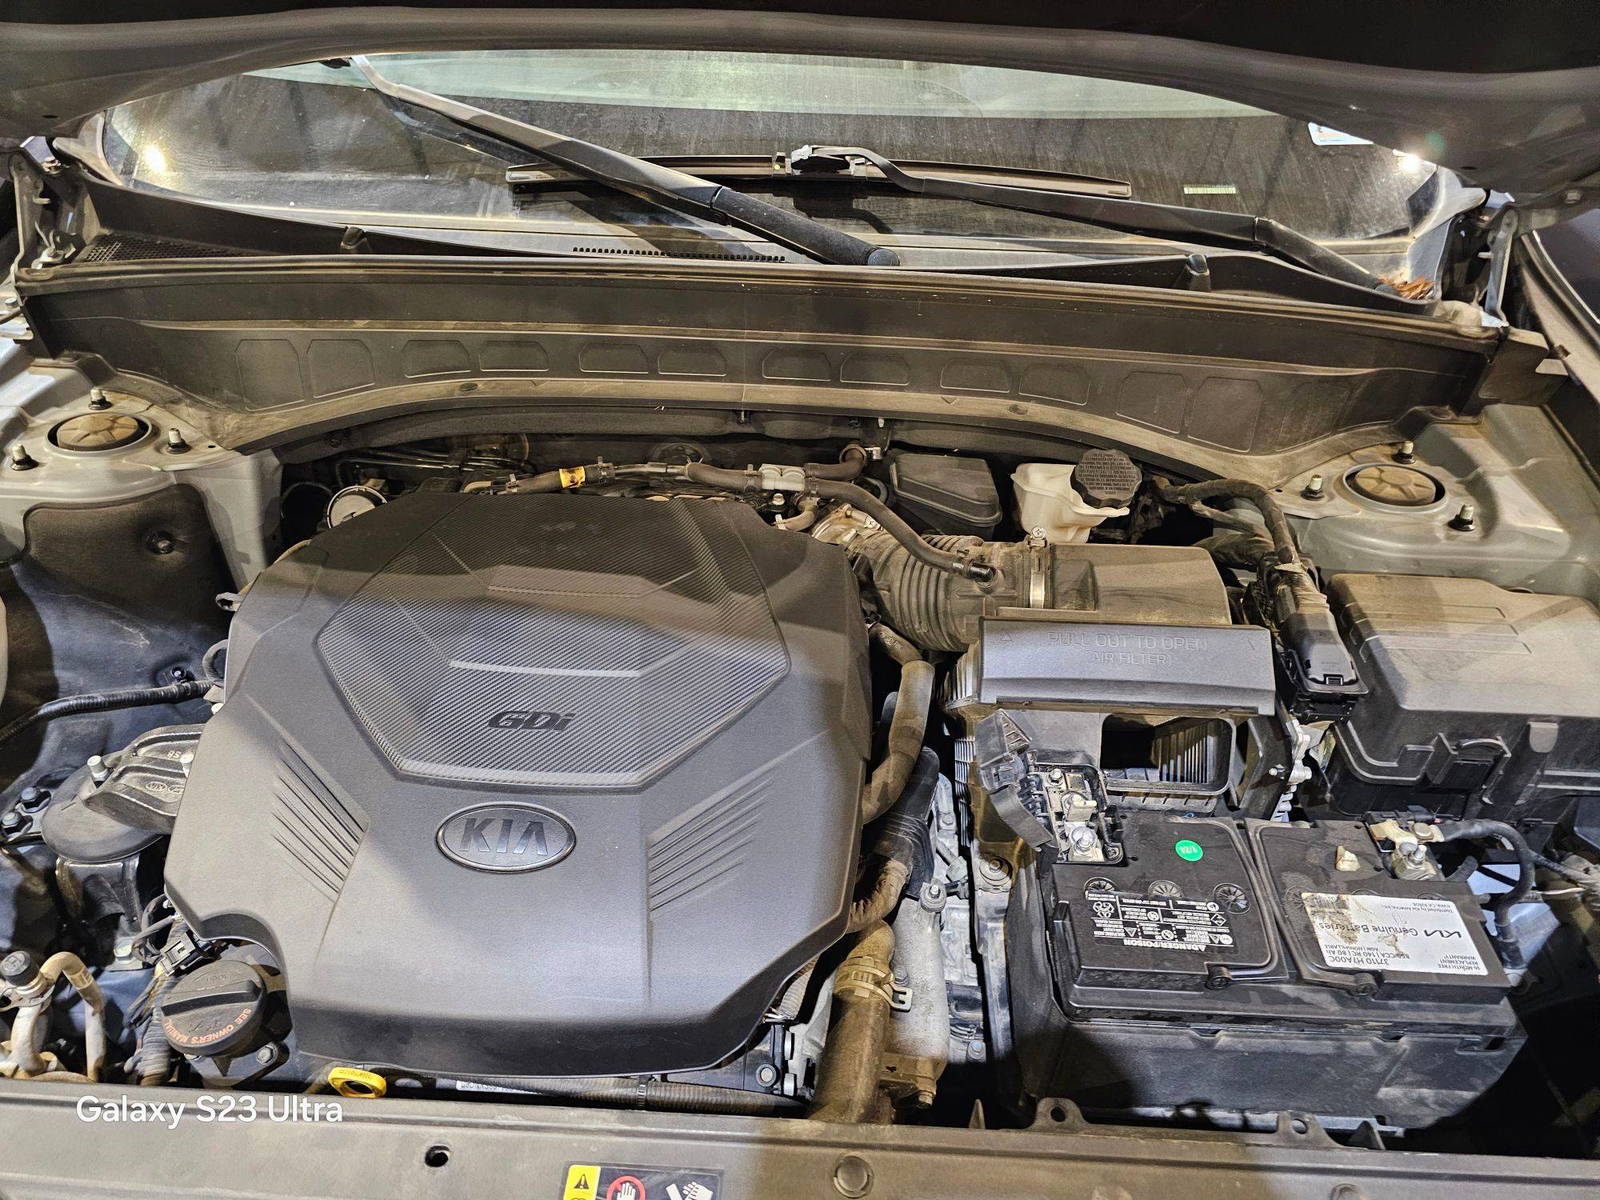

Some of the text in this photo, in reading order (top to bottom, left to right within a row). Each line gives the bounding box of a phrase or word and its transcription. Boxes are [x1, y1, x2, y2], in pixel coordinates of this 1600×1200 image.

[1047, 632, 1208, 651] PULL OUT TO OPEN
[488, 710, 576, 731] GDi
[460, 817, 549, 856] KIA
[1319, 922, 1370, 933] Batteries
[1372, 926, 1419, 937] Genuine
[1366, 957, 1390, 965] 37110
[164, 1008, 252, 1044] SEE OWNER'S MANUAL
